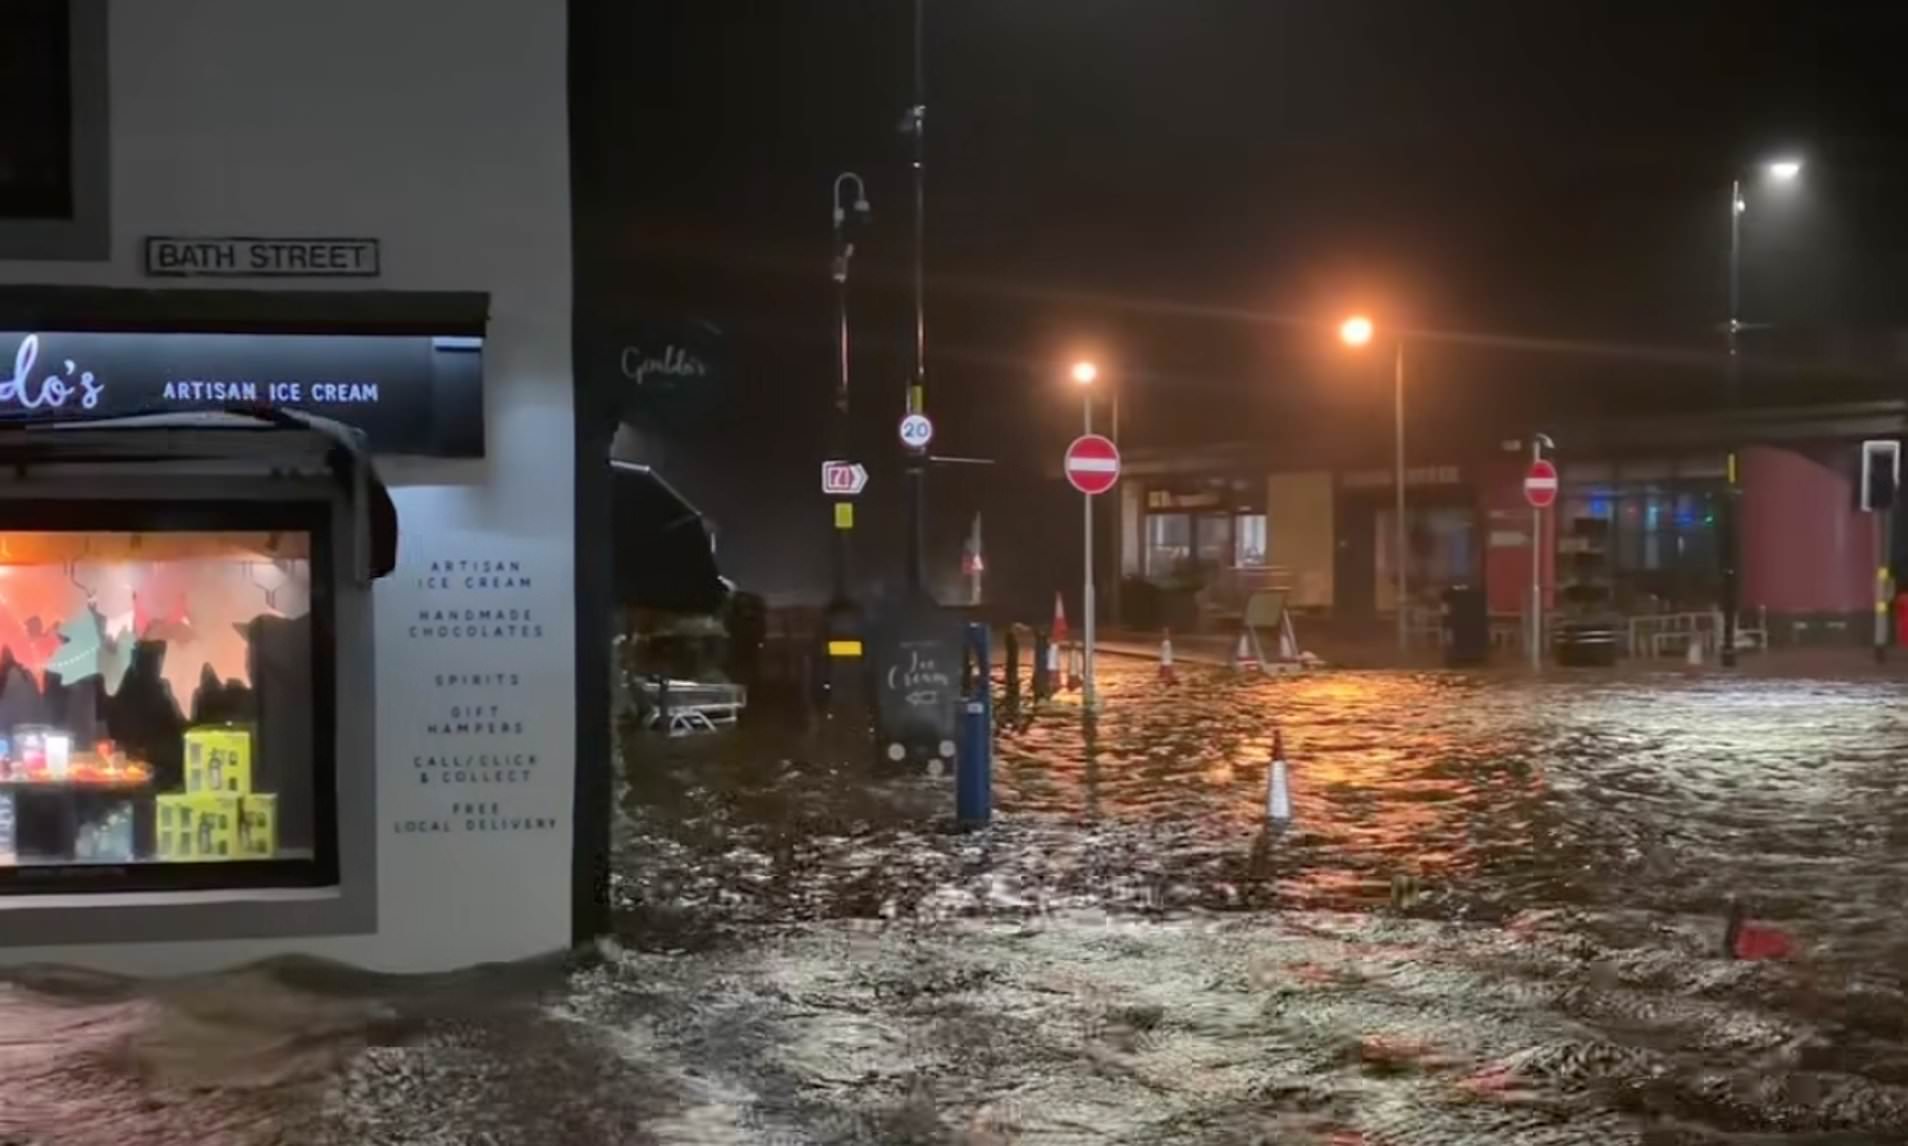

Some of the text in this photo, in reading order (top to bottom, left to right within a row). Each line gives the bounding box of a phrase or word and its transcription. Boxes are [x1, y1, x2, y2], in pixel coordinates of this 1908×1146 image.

[158, 243, 366, 269] BATH STREET
[162, 381, 379, 402] ARTISAN ICE CREAM
[903, 421, 929, 438] 20
[431, 560, 520, 573] ARTISAN
[418, 577, 532, 590] ICE CREAM
[418, 609, 532, 622] HANDMADE
[408, 625, 544, 638] CHOCOLATES
[434, 673, 519, 687] SPIRITS
[450, 705, 498, 718] GIFT
[426, 721, 524, 735] HAMPERS
[413, 753, 537, 768] CALL/CLICK
[441, 769, 531, 784] COLLECT
[452, 801, 499, 815] FREE
[393, 816, 557, 834] LOCAL DELIVERY
